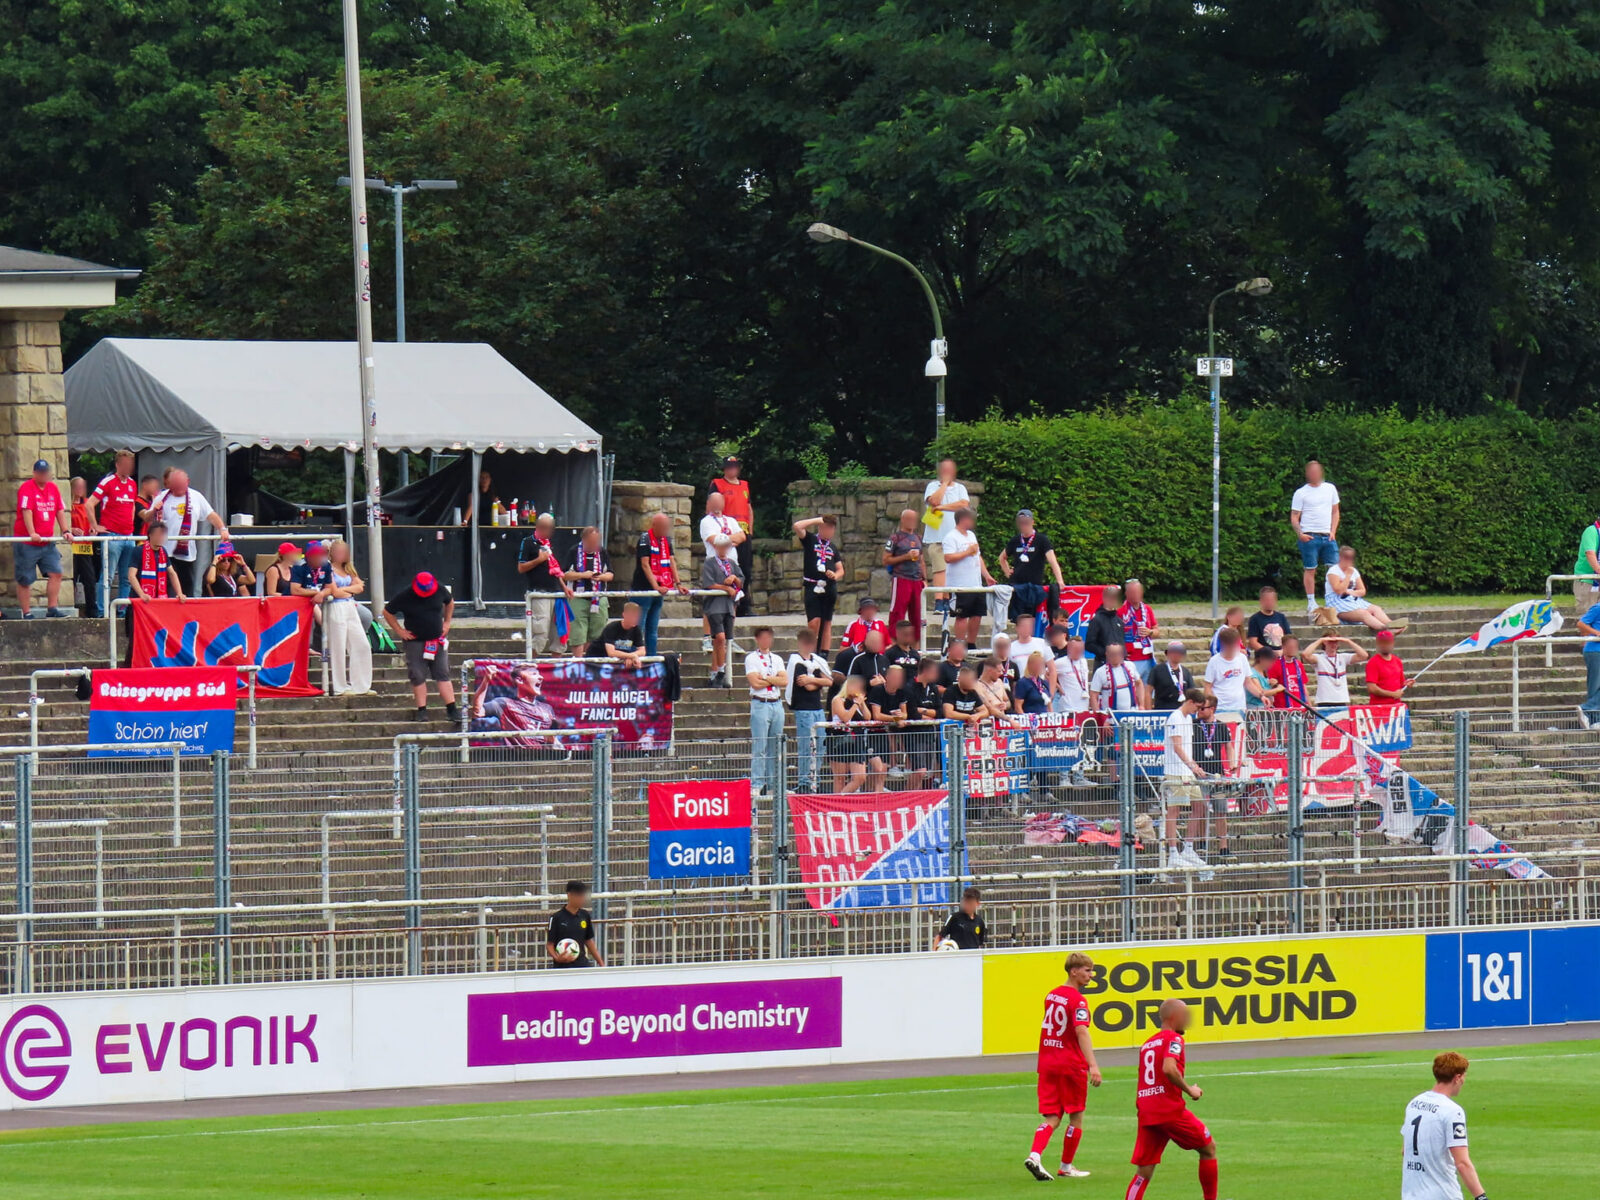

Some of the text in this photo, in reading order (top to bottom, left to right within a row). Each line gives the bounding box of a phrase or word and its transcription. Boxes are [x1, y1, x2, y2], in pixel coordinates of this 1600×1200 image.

[100, 681, 226, 702] Reisegruppe Süd
[565, 689, 653, 704] JULIAN HÜGEL
[115, 721, 208, 741] Schön hier!
[580, 708, 637, 721] FANCLUB
[1355, 705, 1406, 745] AWA
[946, 755, 1027, 776] TADION
[673, 792, 729, 819] Fonsi
[666, 840, 735, 867] Garcia
[1079, 953, 1337, 995] BORUSSIA
[1467, 952, 1522, 1002] 1&1
[502, 1001, 809, 1045] Leading Beyond Chemistry
[1041, 1003, 1068, 1037] 49
[95, 1014, 319, 1074] EVONIK
[1144, 1050, 1155, 1085] 8
[1411, 1115, 1422, 1156] 1
